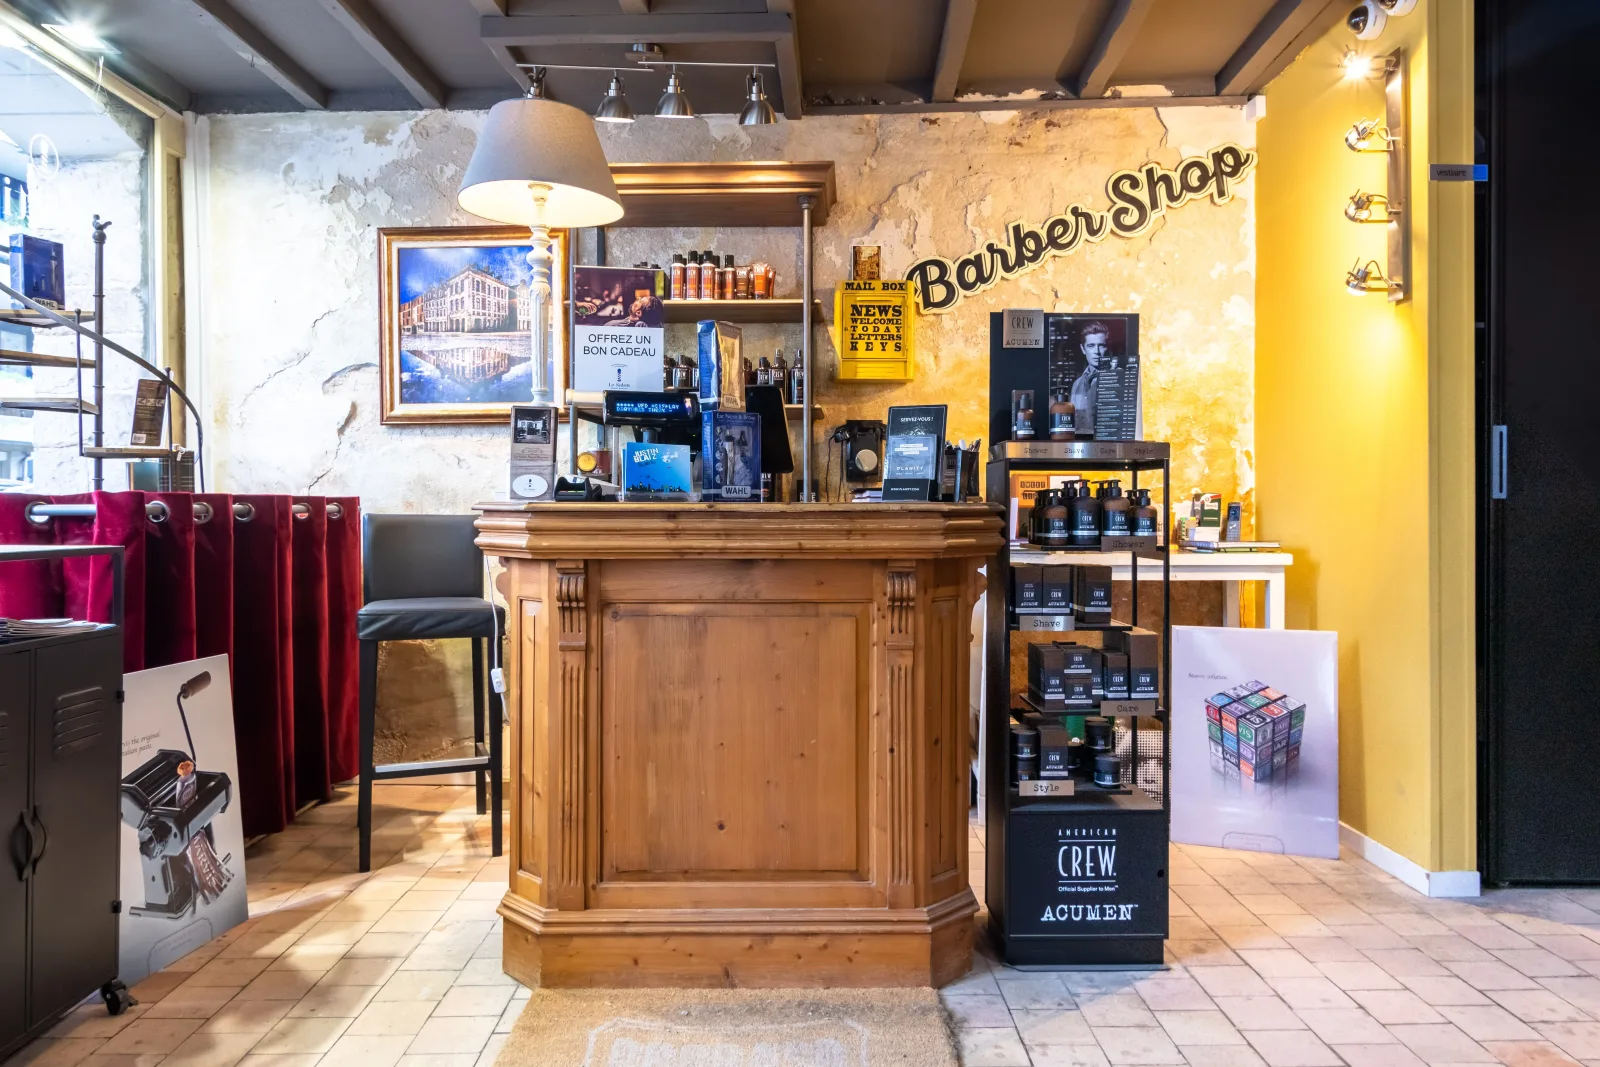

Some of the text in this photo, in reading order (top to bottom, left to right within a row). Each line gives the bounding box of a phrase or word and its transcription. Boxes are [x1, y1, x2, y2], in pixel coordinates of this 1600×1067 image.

[908, 144, 1252, 310] Barber Shop
[845, 282, 905, 290] MAIL BOX
[34, 298, 55, 308] WAHL
[850, 304, 902, 317] NEWS
[1012, 316, 1034, 329] CREW
[588, 334, 651, 344] OFFREZ UN
[584, 346, 656, 356] BON CADEAU
[850, 342, 901, 352] KEYS
[1034, 784, 1060, 793] Style
